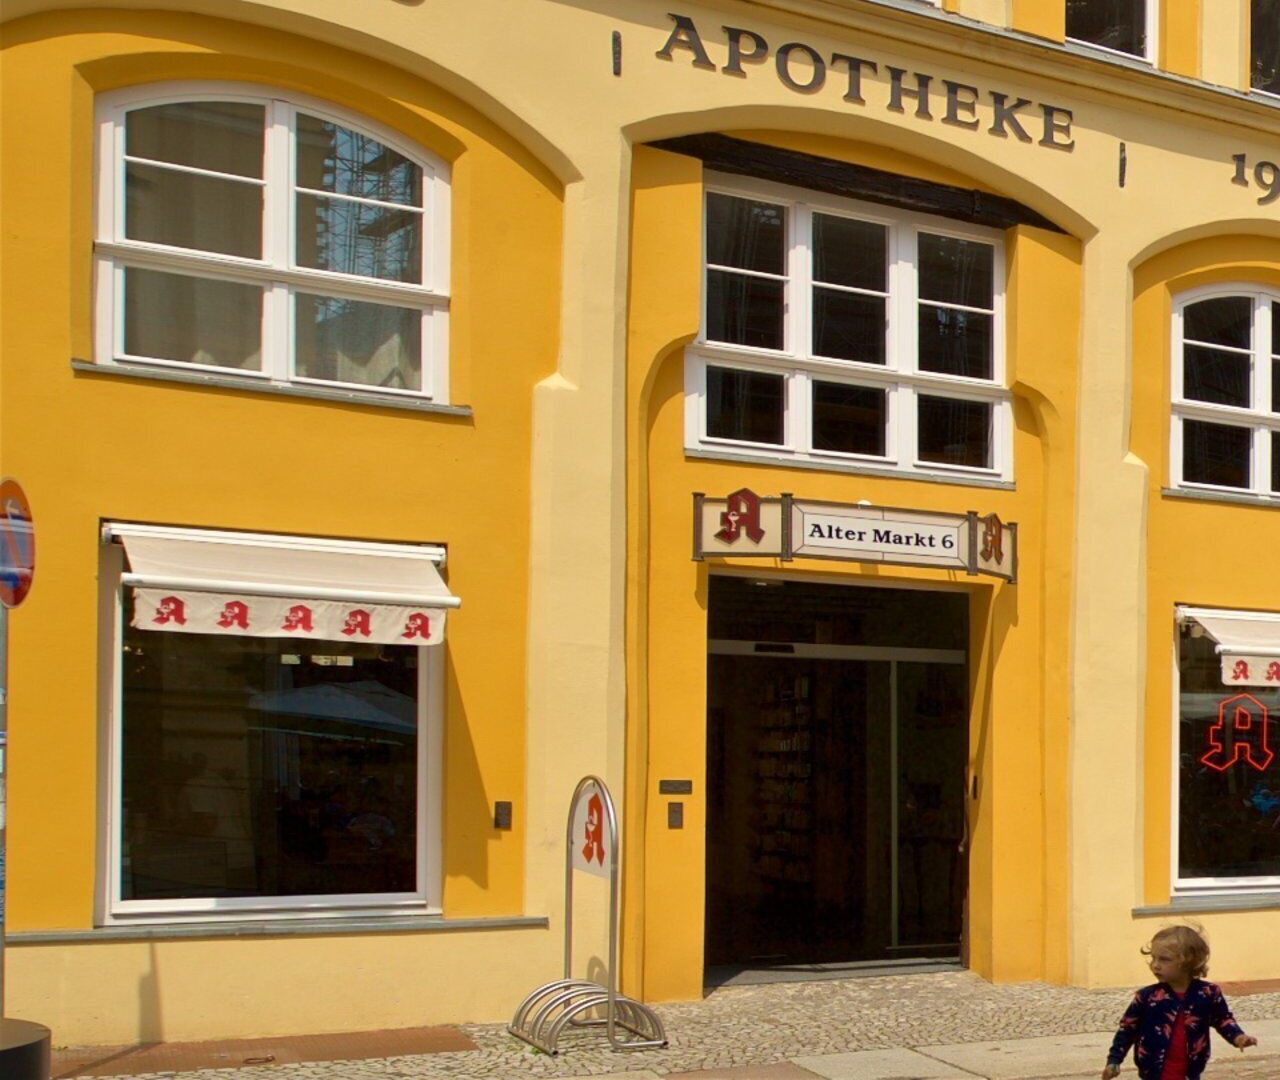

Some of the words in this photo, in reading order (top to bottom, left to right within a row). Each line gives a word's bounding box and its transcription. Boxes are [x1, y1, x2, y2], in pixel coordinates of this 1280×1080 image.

[655, 12, 1077, 152] APOTHEKE
[809, 522, 868, 543] Alter
[872, 528, 937, 548] Markt
[940, 534, 955, 550] 6
